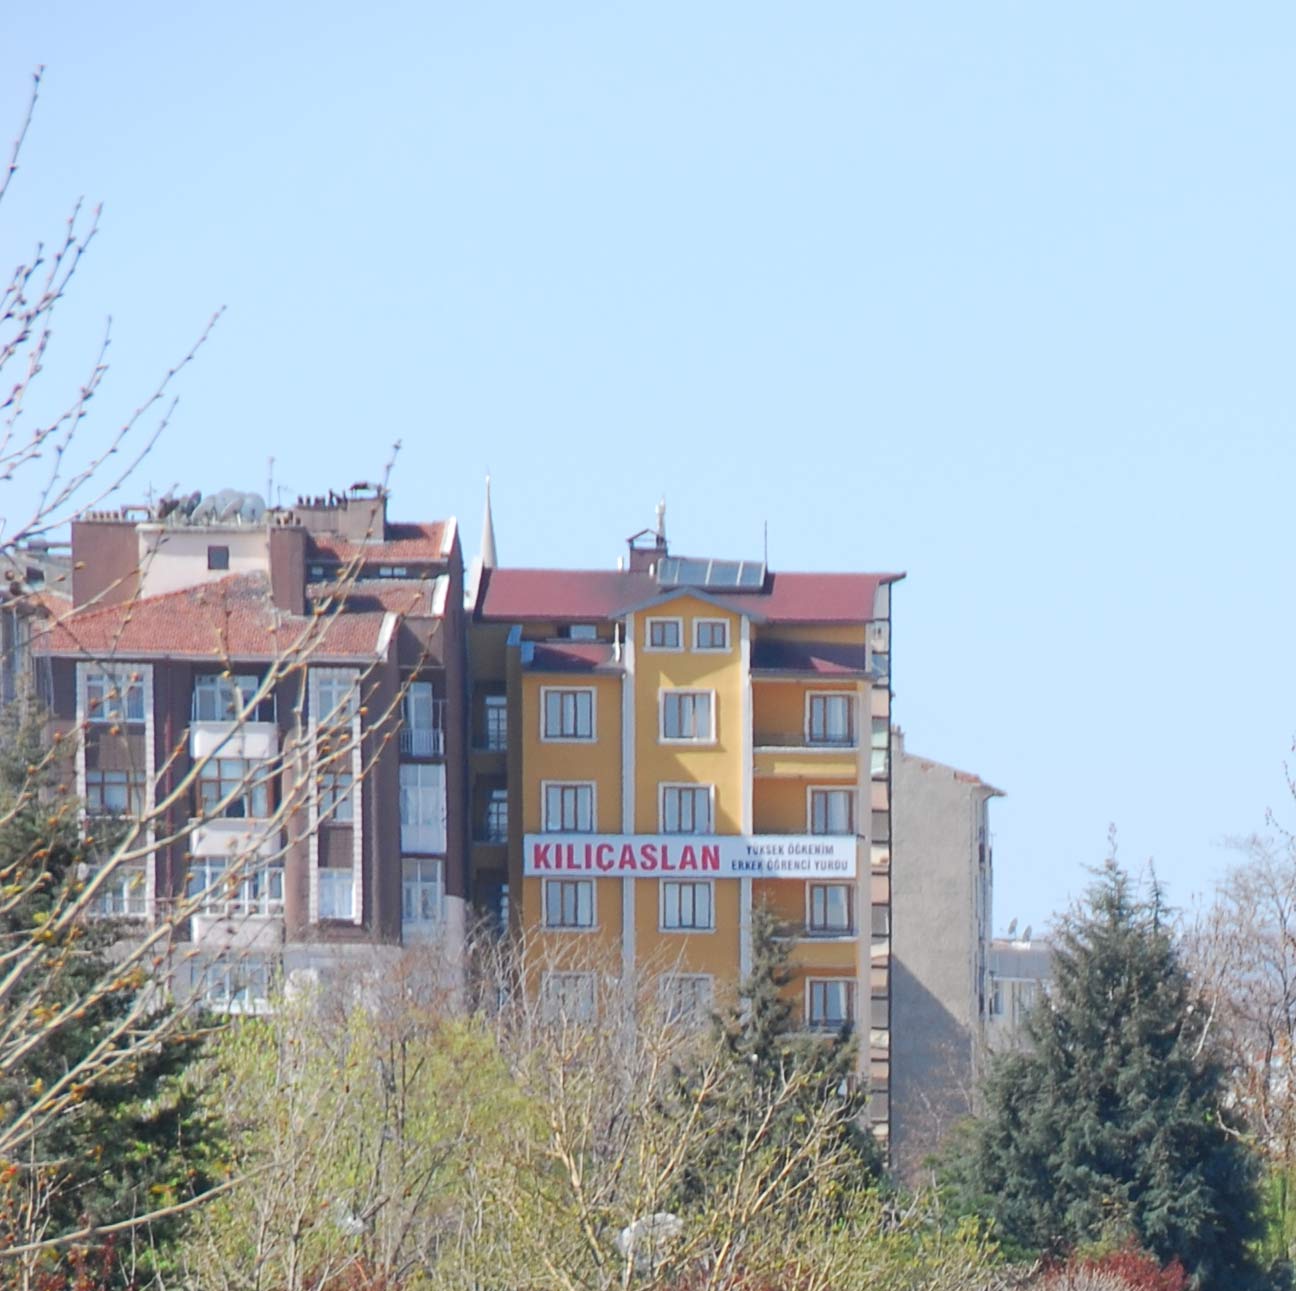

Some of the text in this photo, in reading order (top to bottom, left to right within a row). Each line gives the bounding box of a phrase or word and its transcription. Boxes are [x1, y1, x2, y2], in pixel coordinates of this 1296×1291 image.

[533, 843, 720, 871] KILIÇASLAN
[731, 860, 763, 871] ERKEK
[814, 860, 848, 871] YURDU
